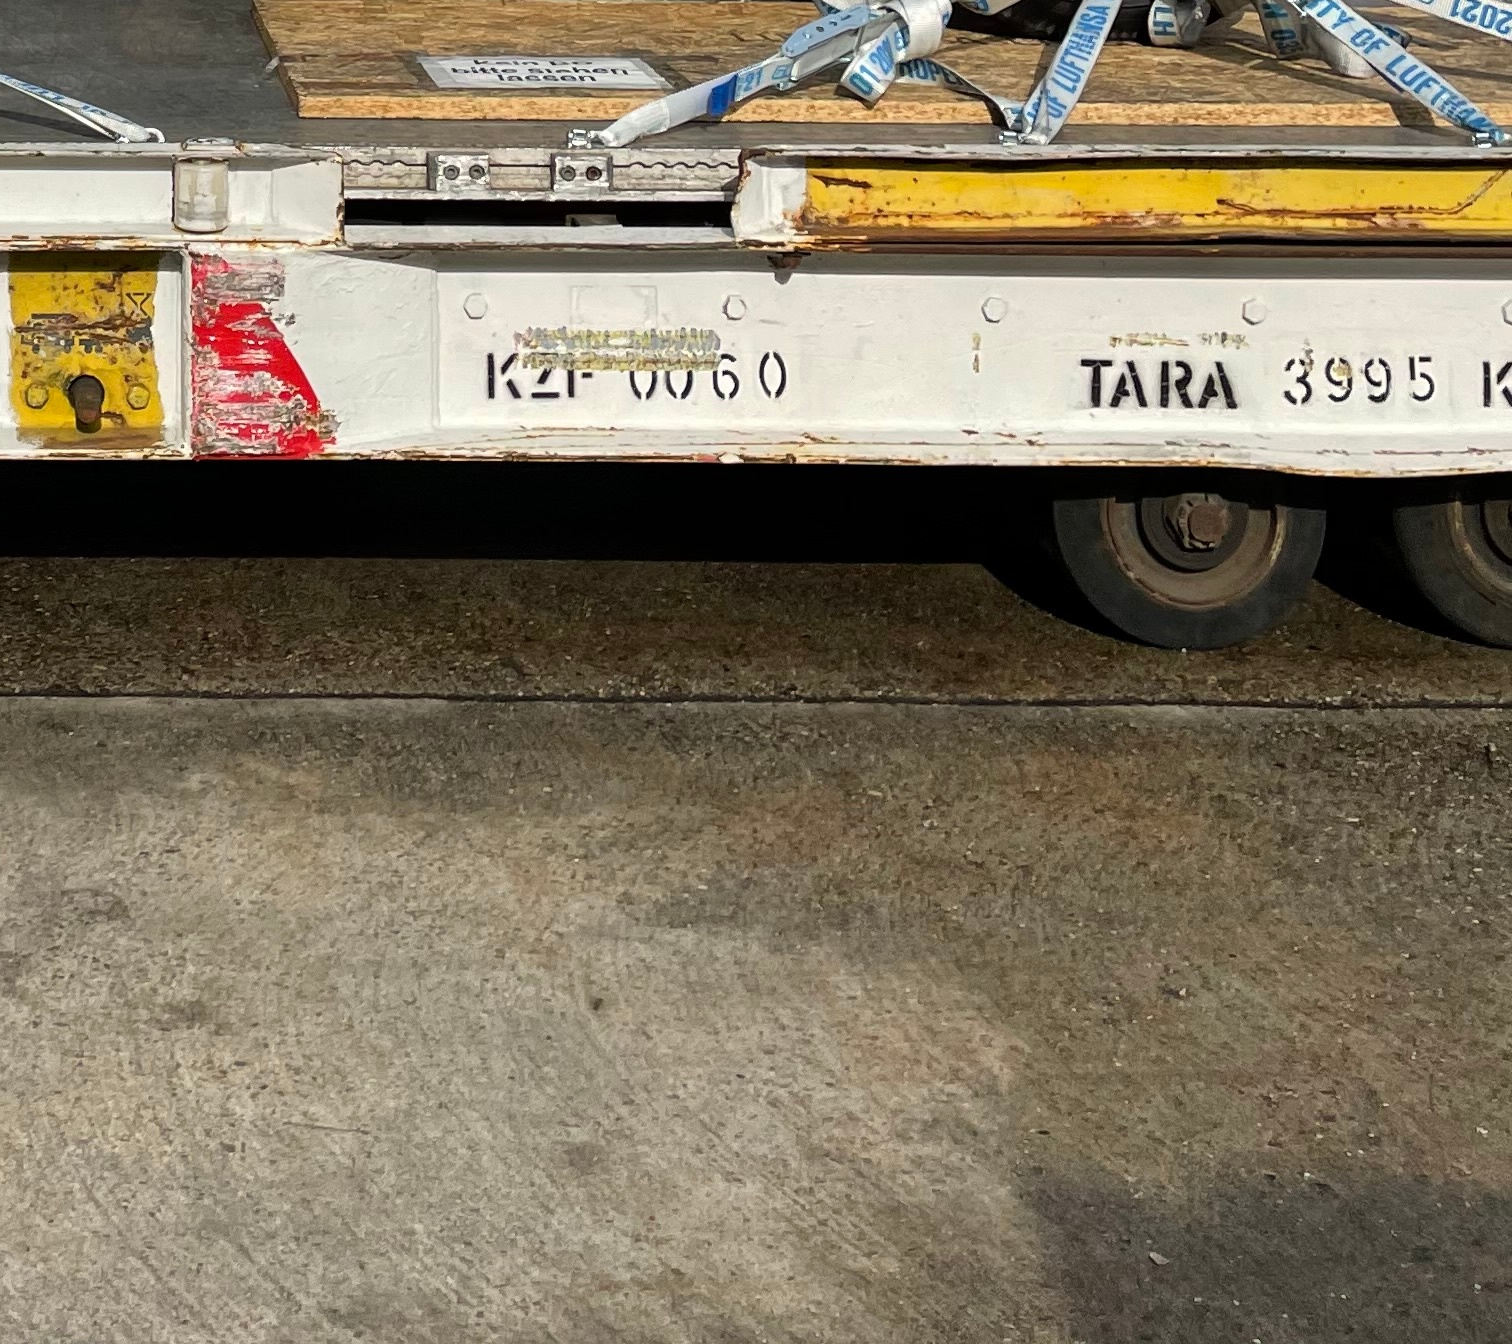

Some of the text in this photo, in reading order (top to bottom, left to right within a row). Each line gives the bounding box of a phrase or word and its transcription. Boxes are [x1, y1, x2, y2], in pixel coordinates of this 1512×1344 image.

[1051, 4, 1111, 94] LUFTHANSA
[1349, 27, 1391, 56] OF
[1080, 358, 1239, 409] TARA
[1283, 356, 1436, 406] 3995
